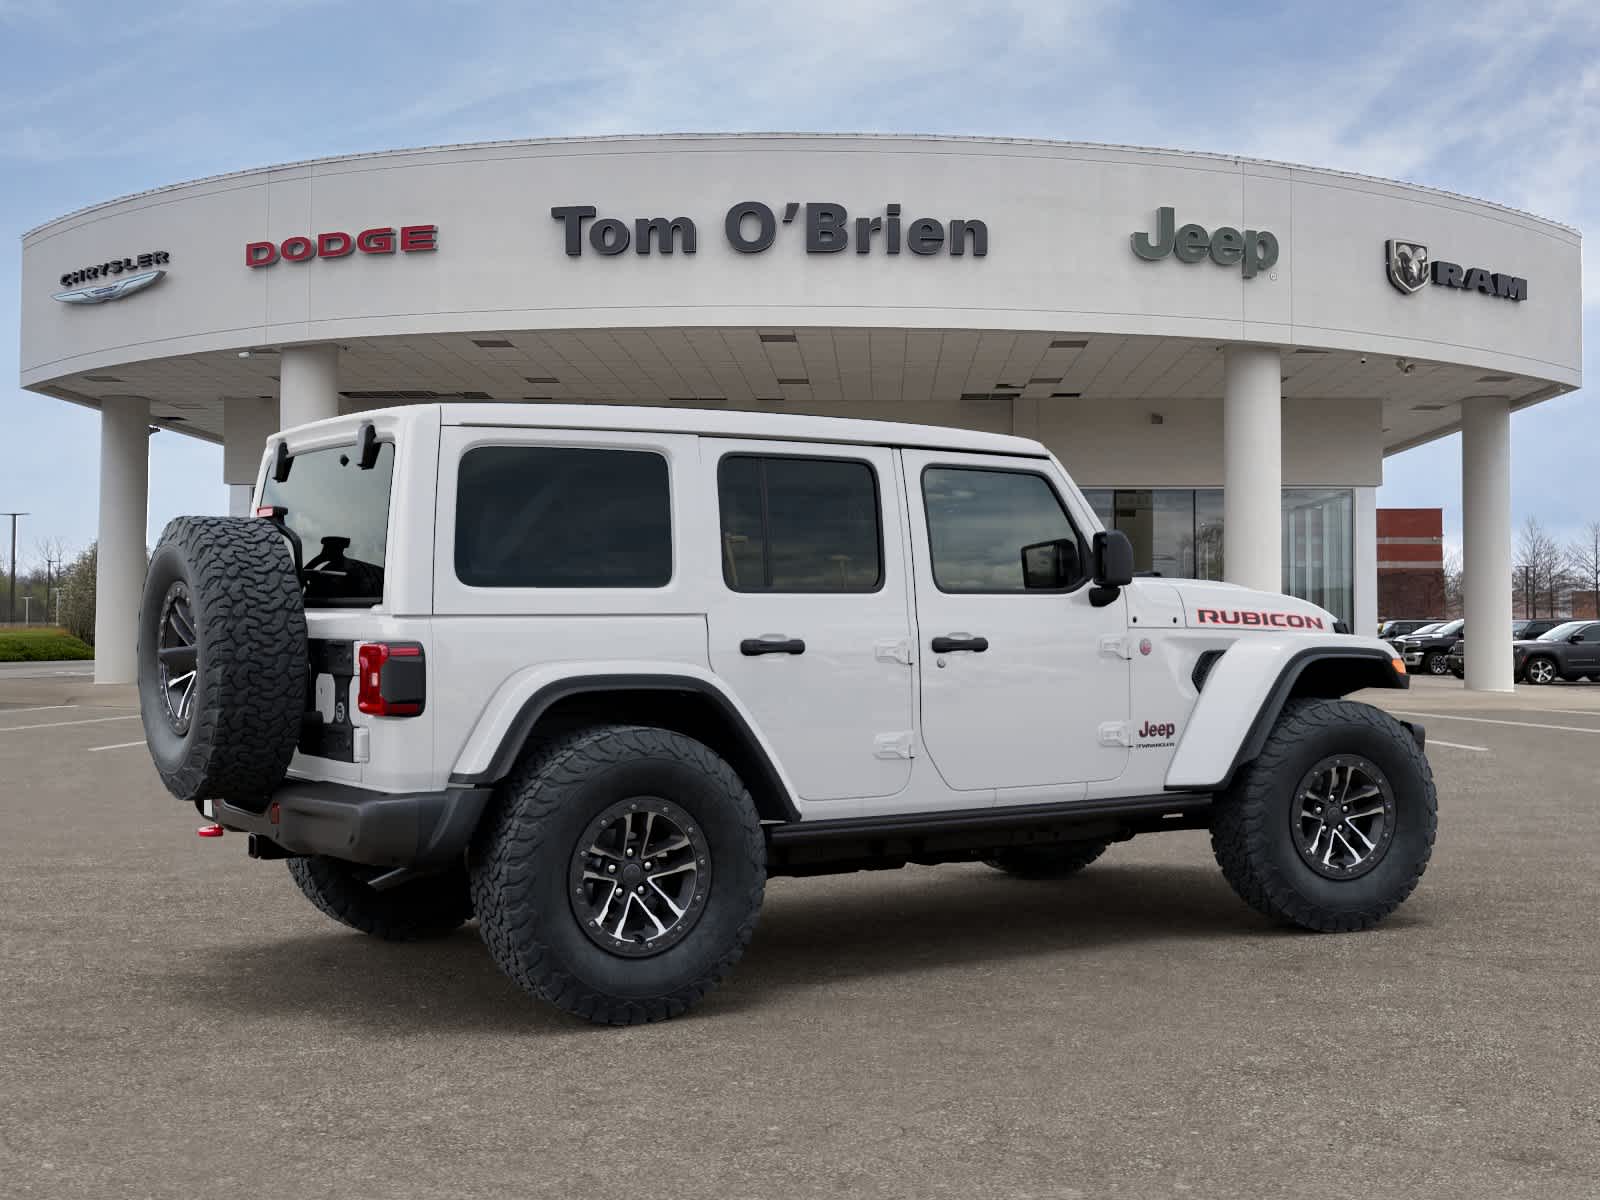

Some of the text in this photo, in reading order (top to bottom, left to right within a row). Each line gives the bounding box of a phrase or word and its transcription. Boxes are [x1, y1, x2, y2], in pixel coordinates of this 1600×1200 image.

[245, 225, 437, 269] DODGE
[551, 201, 988, 256] Tom O'Brien
[1131, 207, 1279, 278] Jeep
[60, 249, 170, 286] CHRYSLER
[1431, 261, 1528, 302] RAM
[1197, 608, 1324, 630] RUBICON
[1138, 720, 1175, 739] Jeep
